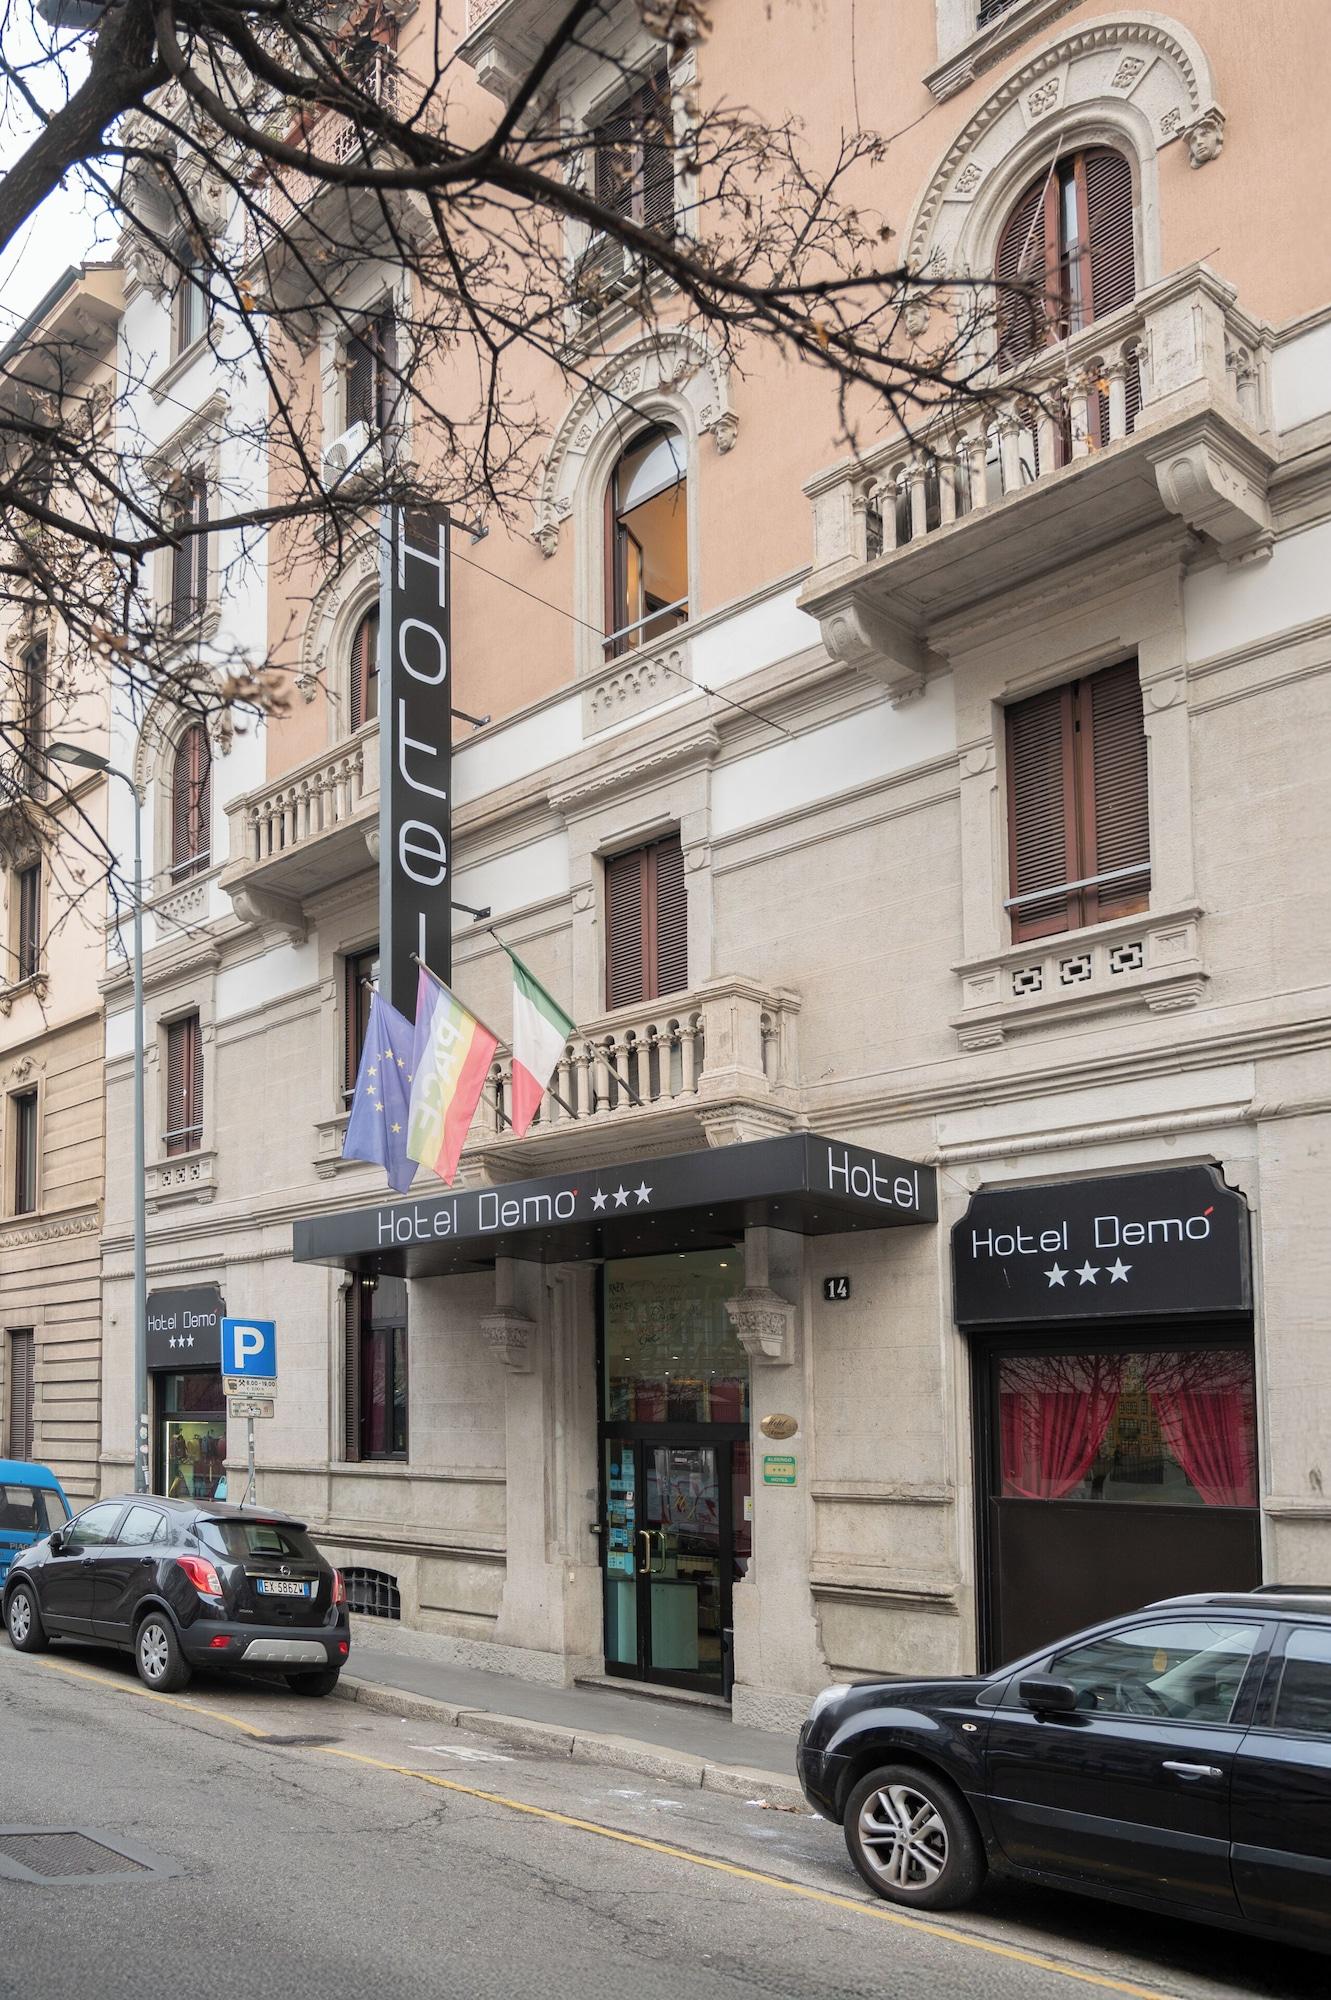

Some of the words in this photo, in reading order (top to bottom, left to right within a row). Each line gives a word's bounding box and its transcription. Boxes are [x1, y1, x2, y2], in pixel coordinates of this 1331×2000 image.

[398, 503, 447, 976] Hotel
[828, 1146, 920, 1211] Hotel
[377, 1199, 458, 1245] Hotel
[972, 1221, 1069, 1258] Hotel
[828, 1279, 848, 1298] 14
[147, 1313, 176, 1331] Hotel
[233, 1326, 265, 1369] P
[264, 1581, 275, 1592] EX
[277, 1582, 303, 1595] 586ZW
